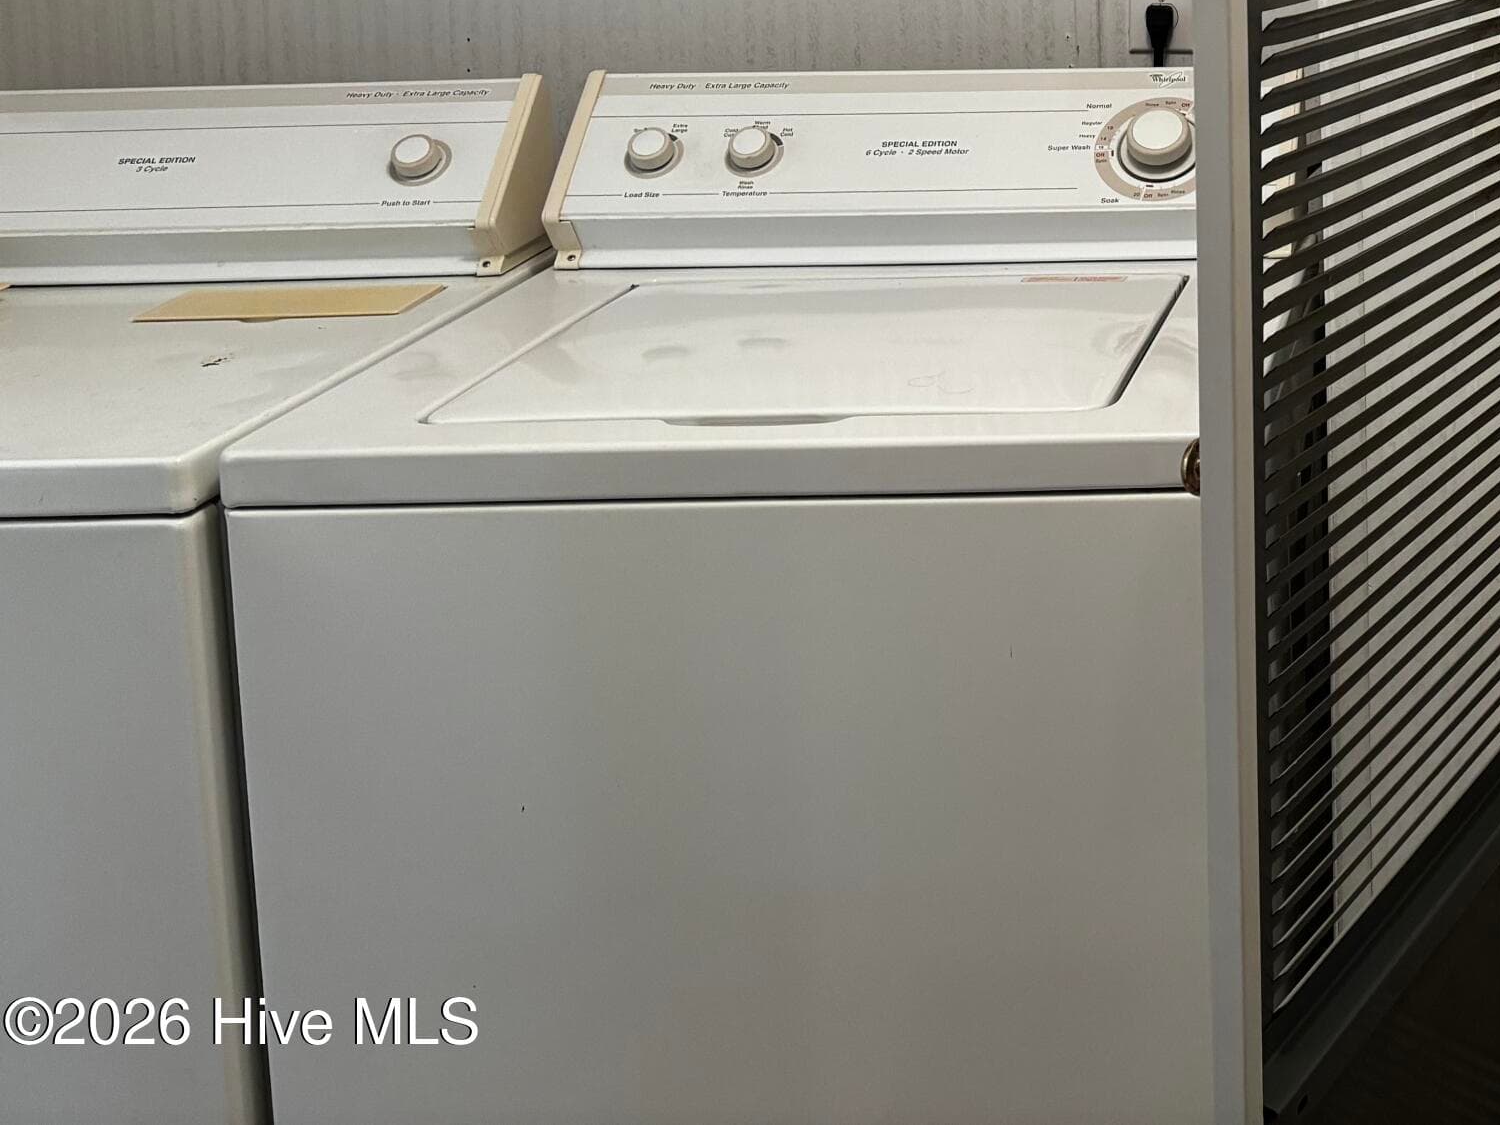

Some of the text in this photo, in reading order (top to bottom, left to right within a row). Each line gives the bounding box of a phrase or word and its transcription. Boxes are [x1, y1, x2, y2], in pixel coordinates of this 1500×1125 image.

[1149, 74, 1186, 84] Whirlpool
[753, 82, 790, 90] Capacity
[346, 91, 371, 99] Heavy
[427, 90, 451, 98] Large
[452, 89, 490, 98] Capacity
[882, 140, 958, 148] SPECIAL EDITION
[873, 149, 898, 157] Cycle
[916, 148, 944, 157] Speed
[118, 156, 196, 165] SPECIAL EDITION
[144, 165, 169, 174] Cycle
[722, 190, 769, 198] Temperature
